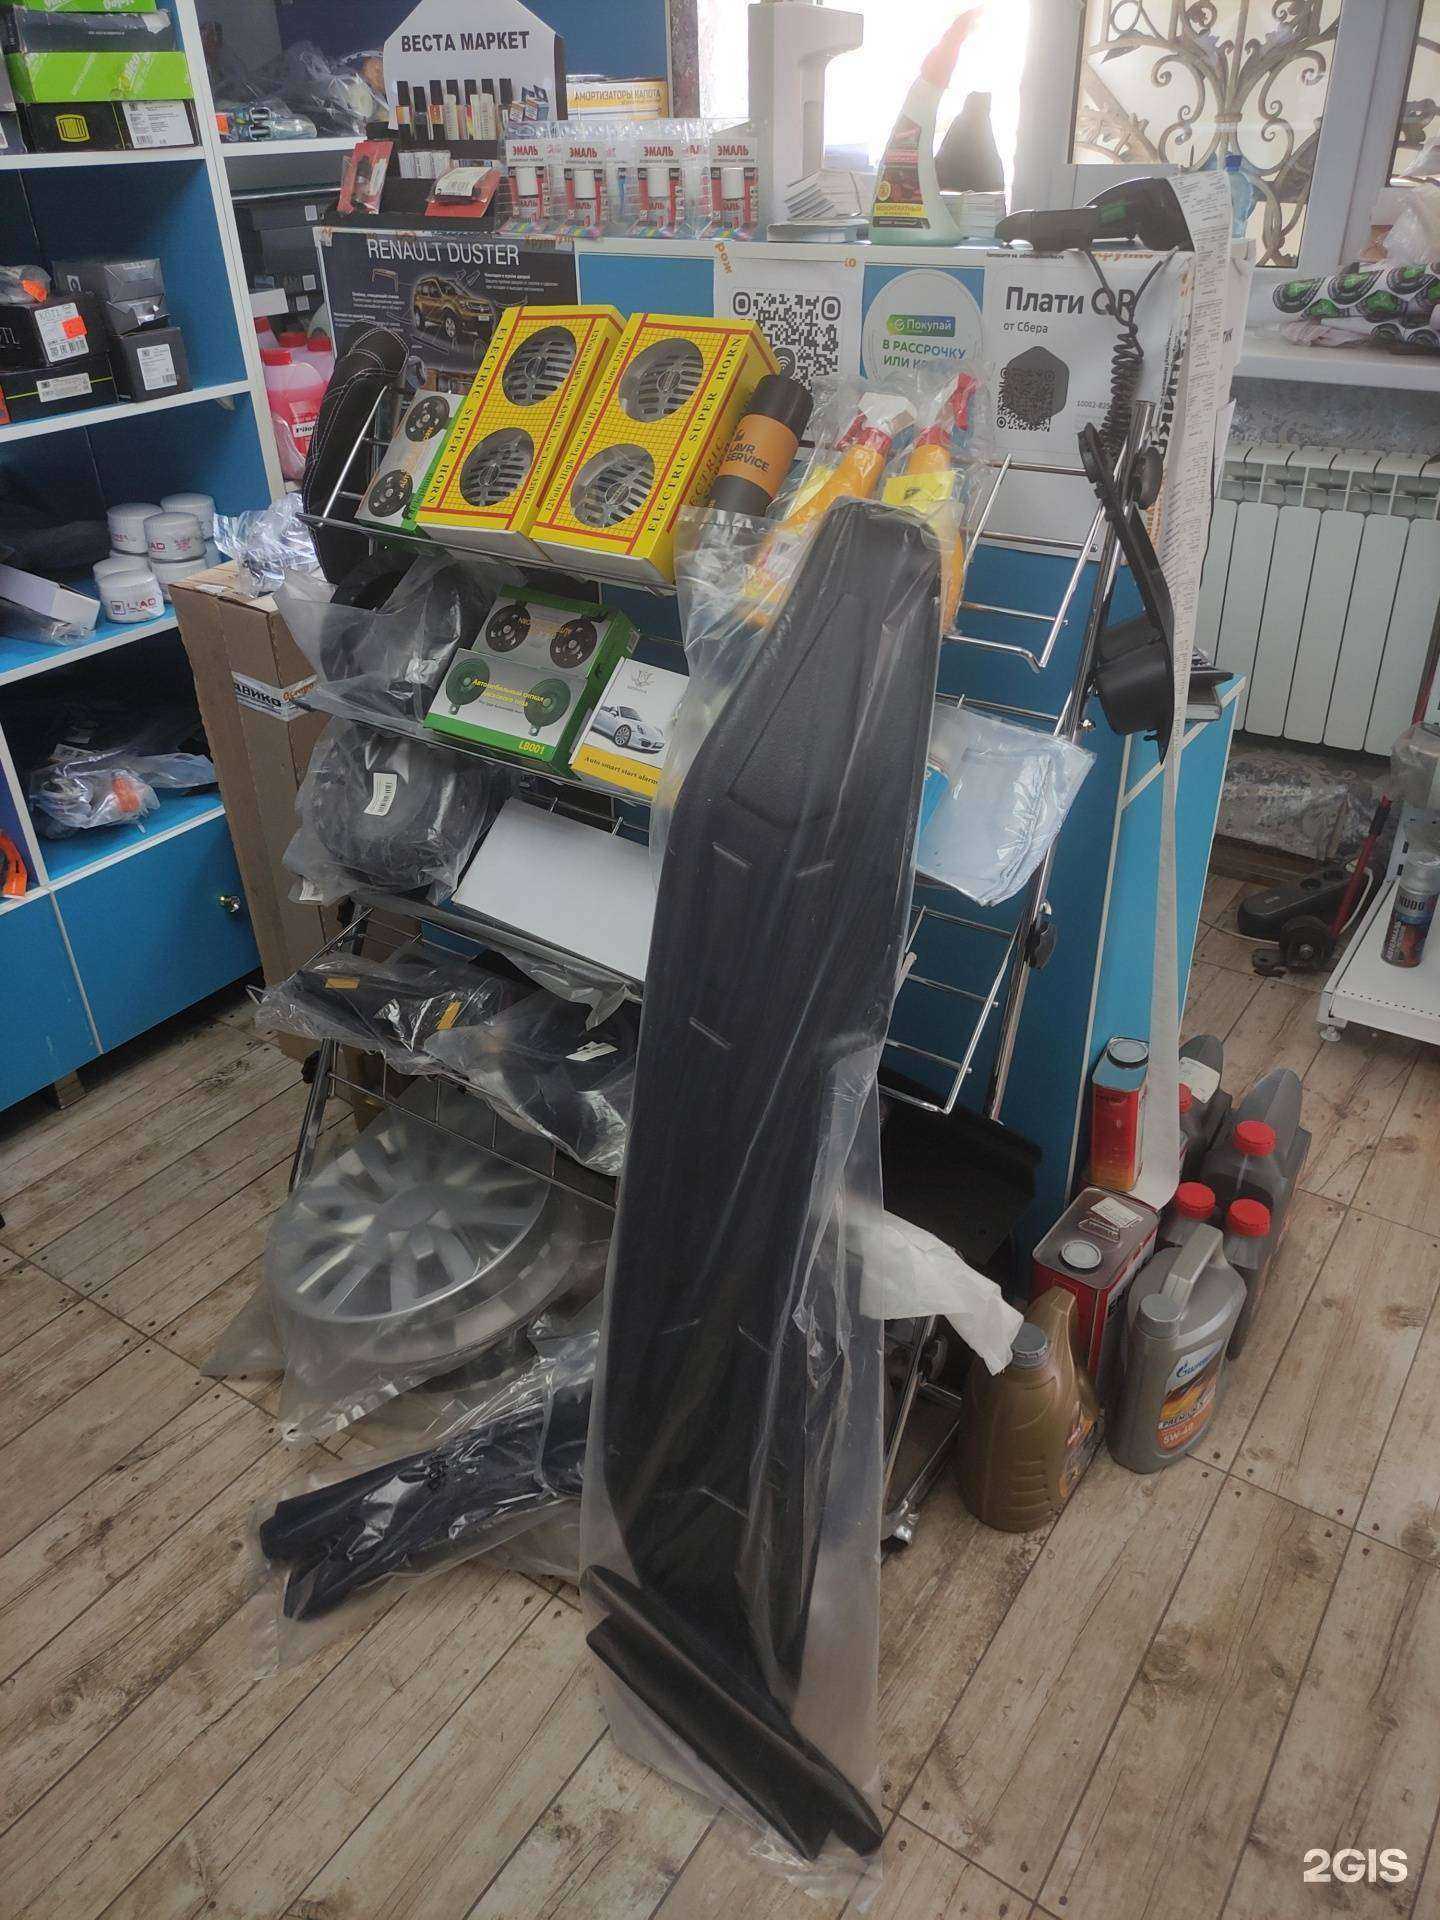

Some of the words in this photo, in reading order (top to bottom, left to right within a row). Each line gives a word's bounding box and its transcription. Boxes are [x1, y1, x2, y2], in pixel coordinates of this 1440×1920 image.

[401, 34, 456, 52] ВЕСТА
[460, 30, 530, 50] МАРКЕТ
[574, 90, 633, 102] АМОРТИЗАТОРЫ
[634, 88, 661, 99] КАПОТА
[512, 145, 539, 157] ЭМАЛЬ
[569, 147, 598, 158] ЭМАЛЬ
[643, 145, 674, 157] ЭМАЛЬ
[717, 144, 749, 156] ЭМАЛЬ
[368, 239, 444, 261] RENAULT
[449, 243, 520, 266] DUSTER
[1006, 286, 1084, 314] Плати
[906, 319, 952, 332] Покупай
[1003, 322, 1016, 332] от
[1017, 321, 1048, 334] Сбера
[882, 340, 890, 349] В
[893, 341, 966, 359] РАССРОЧКУ
[471, 326, 508, 399] ELECTRIC
[883, 355, 909, 368] ИЛИ
[447, 407, 473, 454] SUPER
[645, 451, 691, 533] ELECTRIC
[687, 390, 719, 442] SUPER
[714, 335, 744, 382] HORN
[726, 452, 770, 472] SERVICE
[425, 463, 449, 505] HORN
[584, 756, 601, 766] Auto
[601, 761, 621, 774] smart
